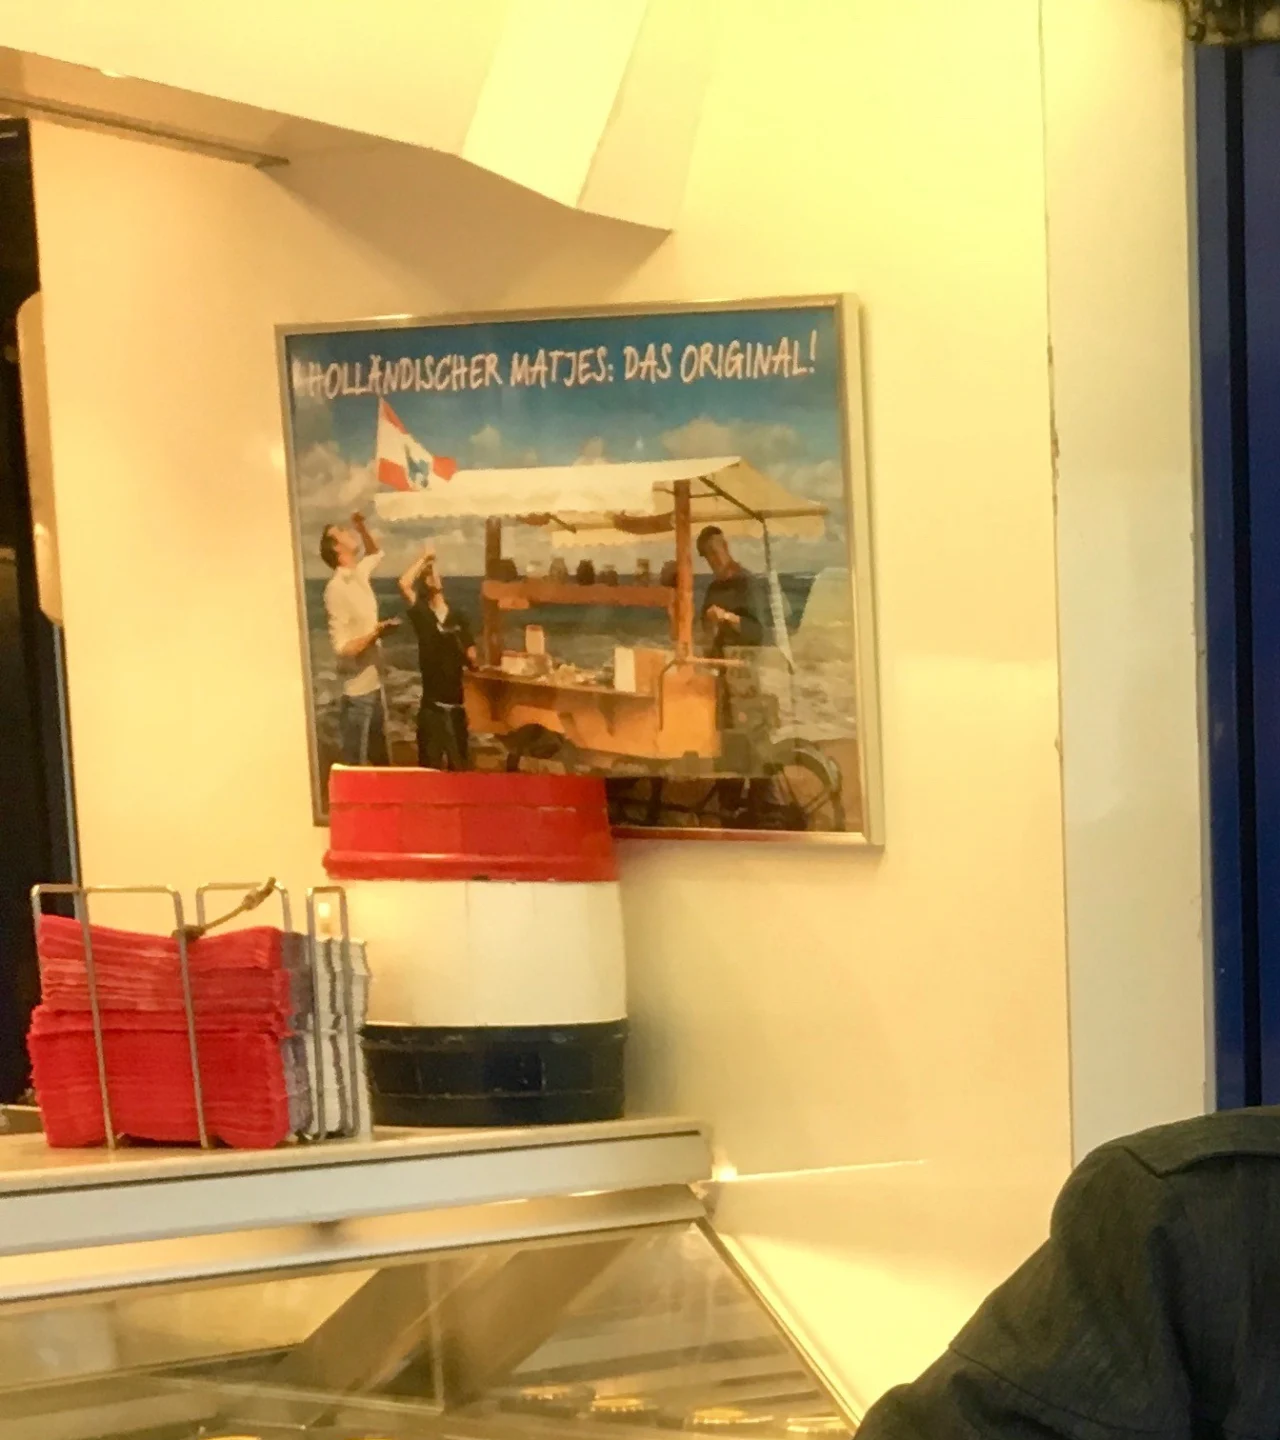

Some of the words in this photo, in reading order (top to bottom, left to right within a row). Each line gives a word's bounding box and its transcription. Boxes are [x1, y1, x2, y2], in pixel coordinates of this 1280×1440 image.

[303, 352, 502, 399] HOLLÄNDISCHER
[510, 346, 613, 388] MATJES:
[624, 340, 673, 381] DAS
[680, 330, 817, 383] ORIGINAL!
